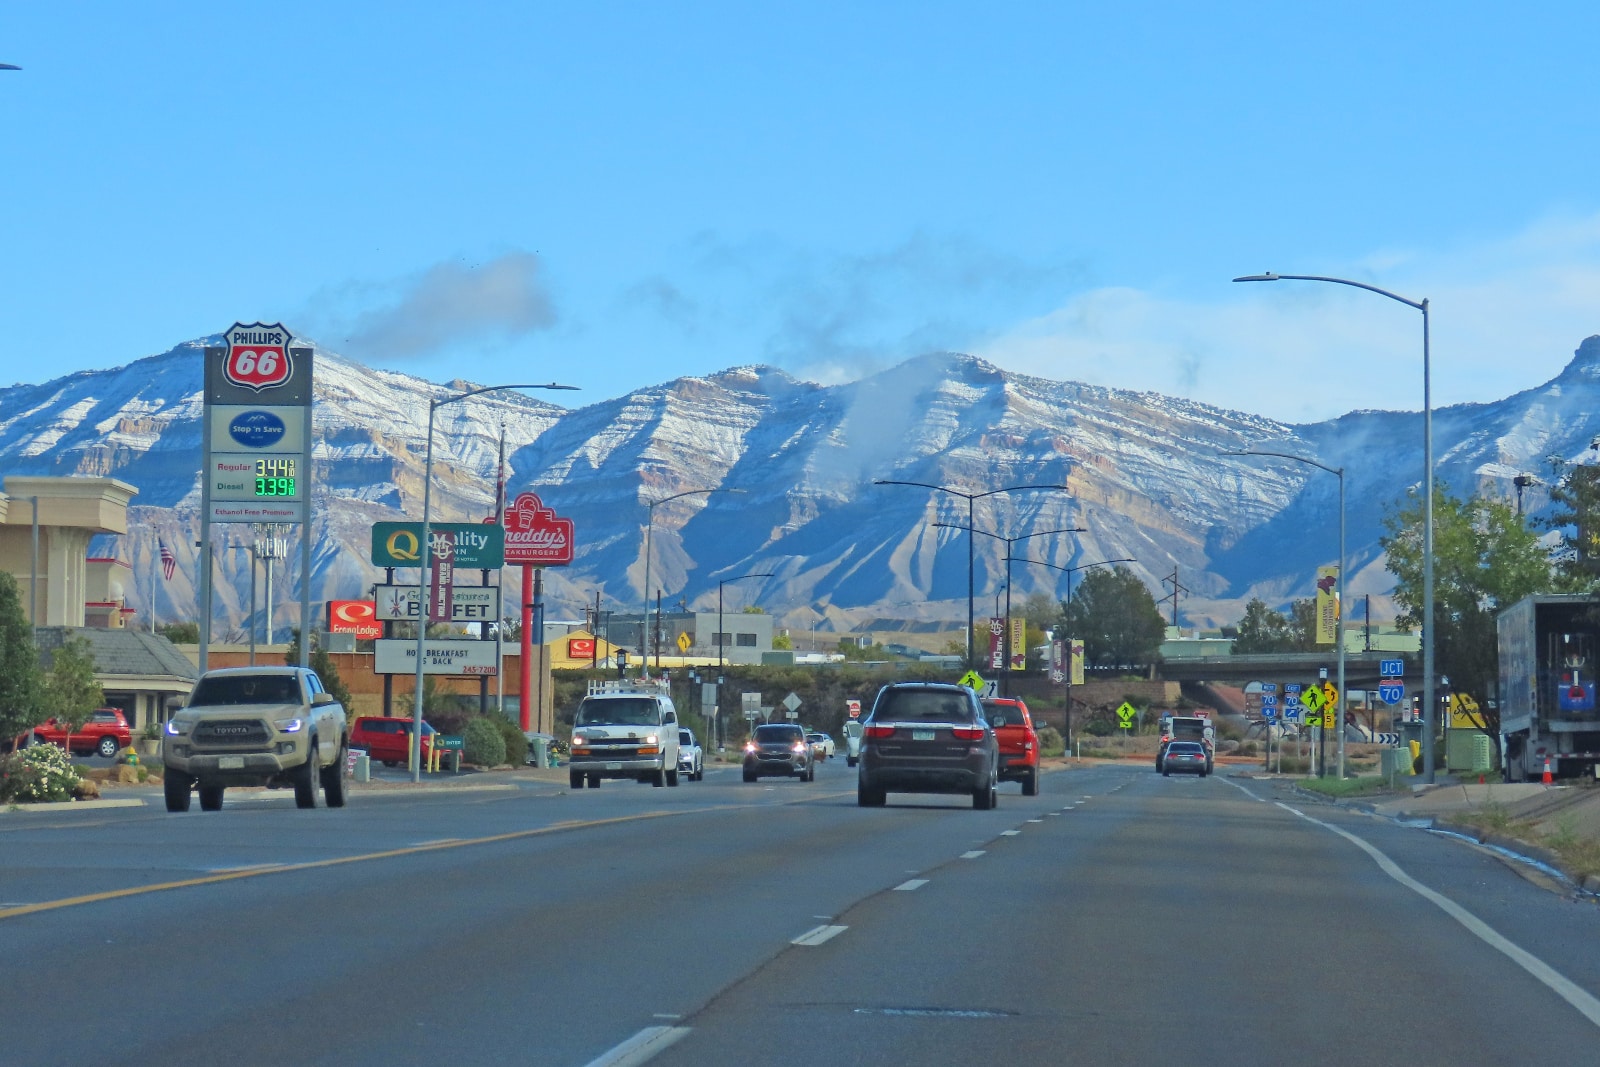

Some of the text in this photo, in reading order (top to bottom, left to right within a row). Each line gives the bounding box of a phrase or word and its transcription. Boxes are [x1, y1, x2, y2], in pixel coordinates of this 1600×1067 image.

[234, 332, 282, 344] PHILLIPS
[235, 350, 279, 375] 66
[233, 425, 251, 434] Stop
[217, 463, 251, 472] Regular
[504, 525, 566, 549] reddy's
[438, 562, 447, 617] GRAND JUNCTION
[407, 602, 490, 617] BFET
[426, 649, 468, 657] BREAKFAST
[433, 657, 452, 665] BACK
[993, 651, 1003, 669] CMU
[463, 666, 496, 674] 245-7200
[1382, 662, 1402, 674] JCT
[1263, 695, 1274, 704] 70
[1287, 696, 1298, 704] 70
[1383, 688, 1400, 701] 70
